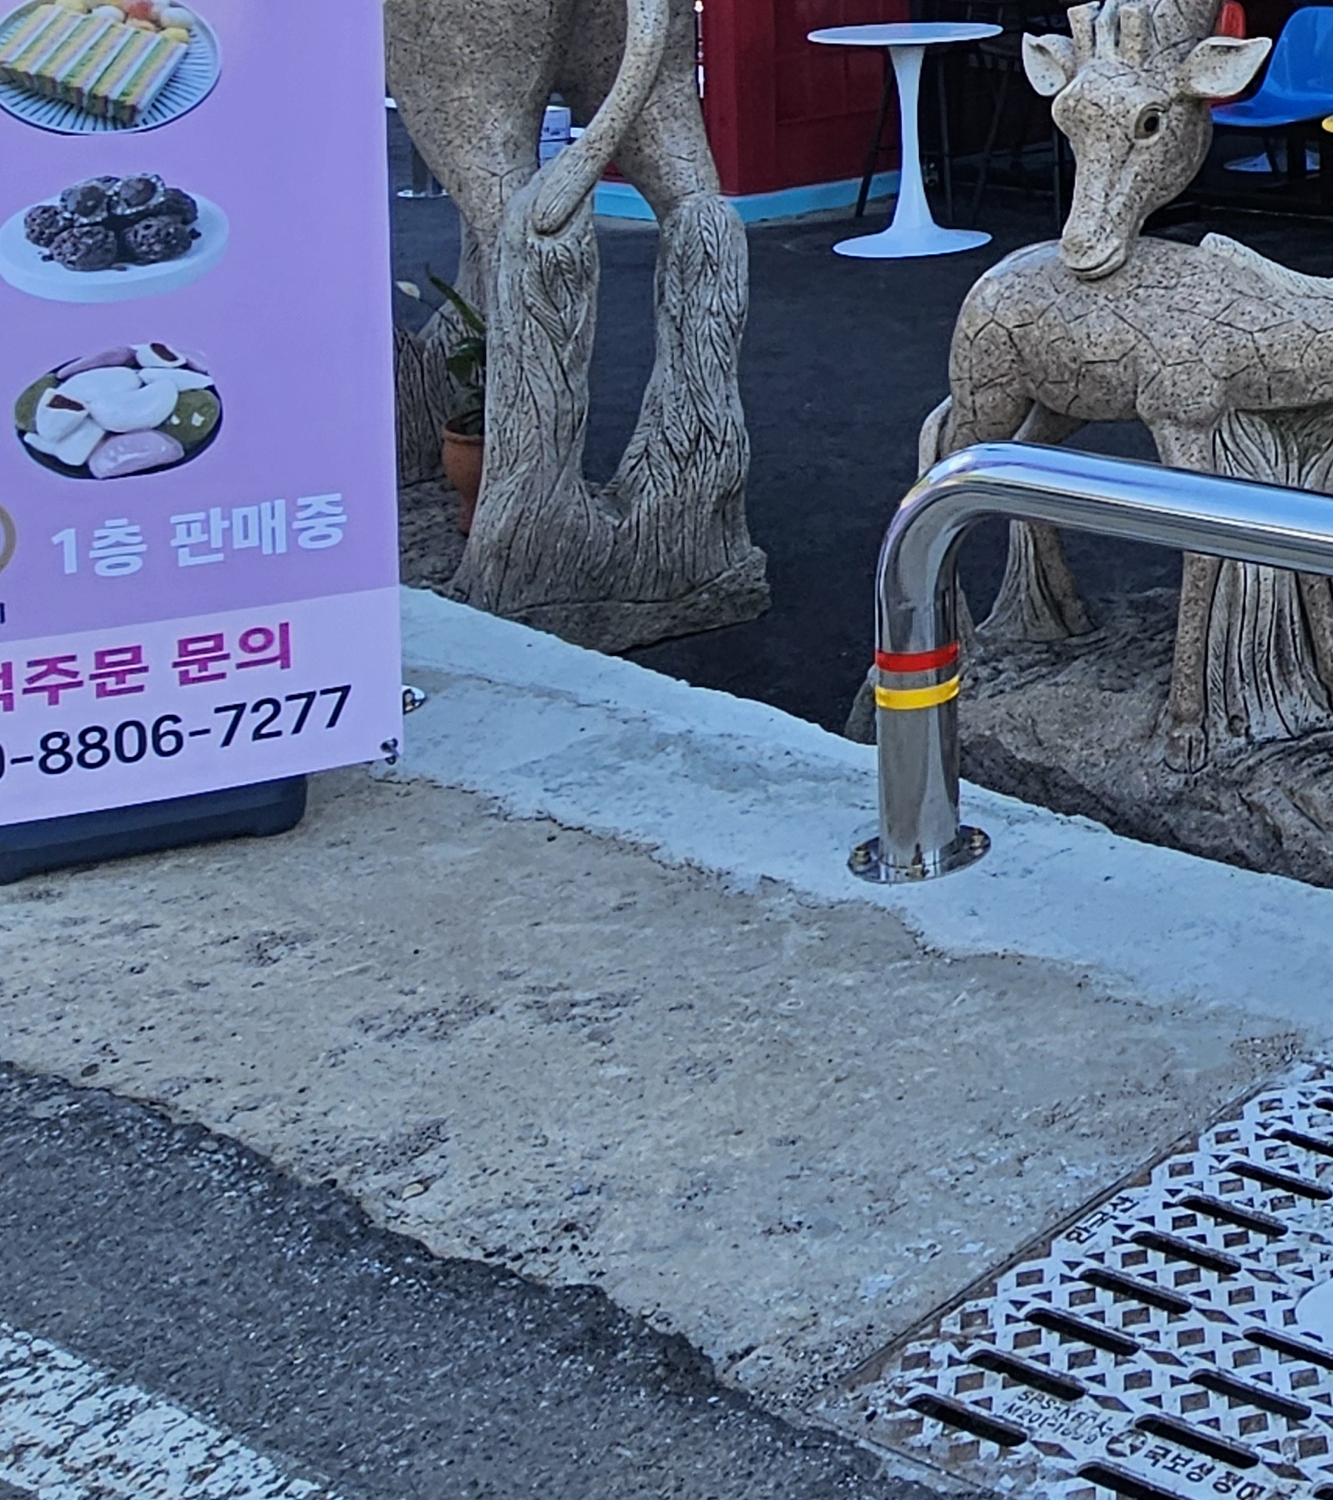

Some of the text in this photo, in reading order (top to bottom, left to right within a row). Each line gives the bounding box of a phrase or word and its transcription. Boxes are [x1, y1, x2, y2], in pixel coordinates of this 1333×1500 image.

[51, 493, 348, 577] 1층 판매중
[172, 622, 292, 687] 문의
[0, 684, 352, 781] -8806-7277
